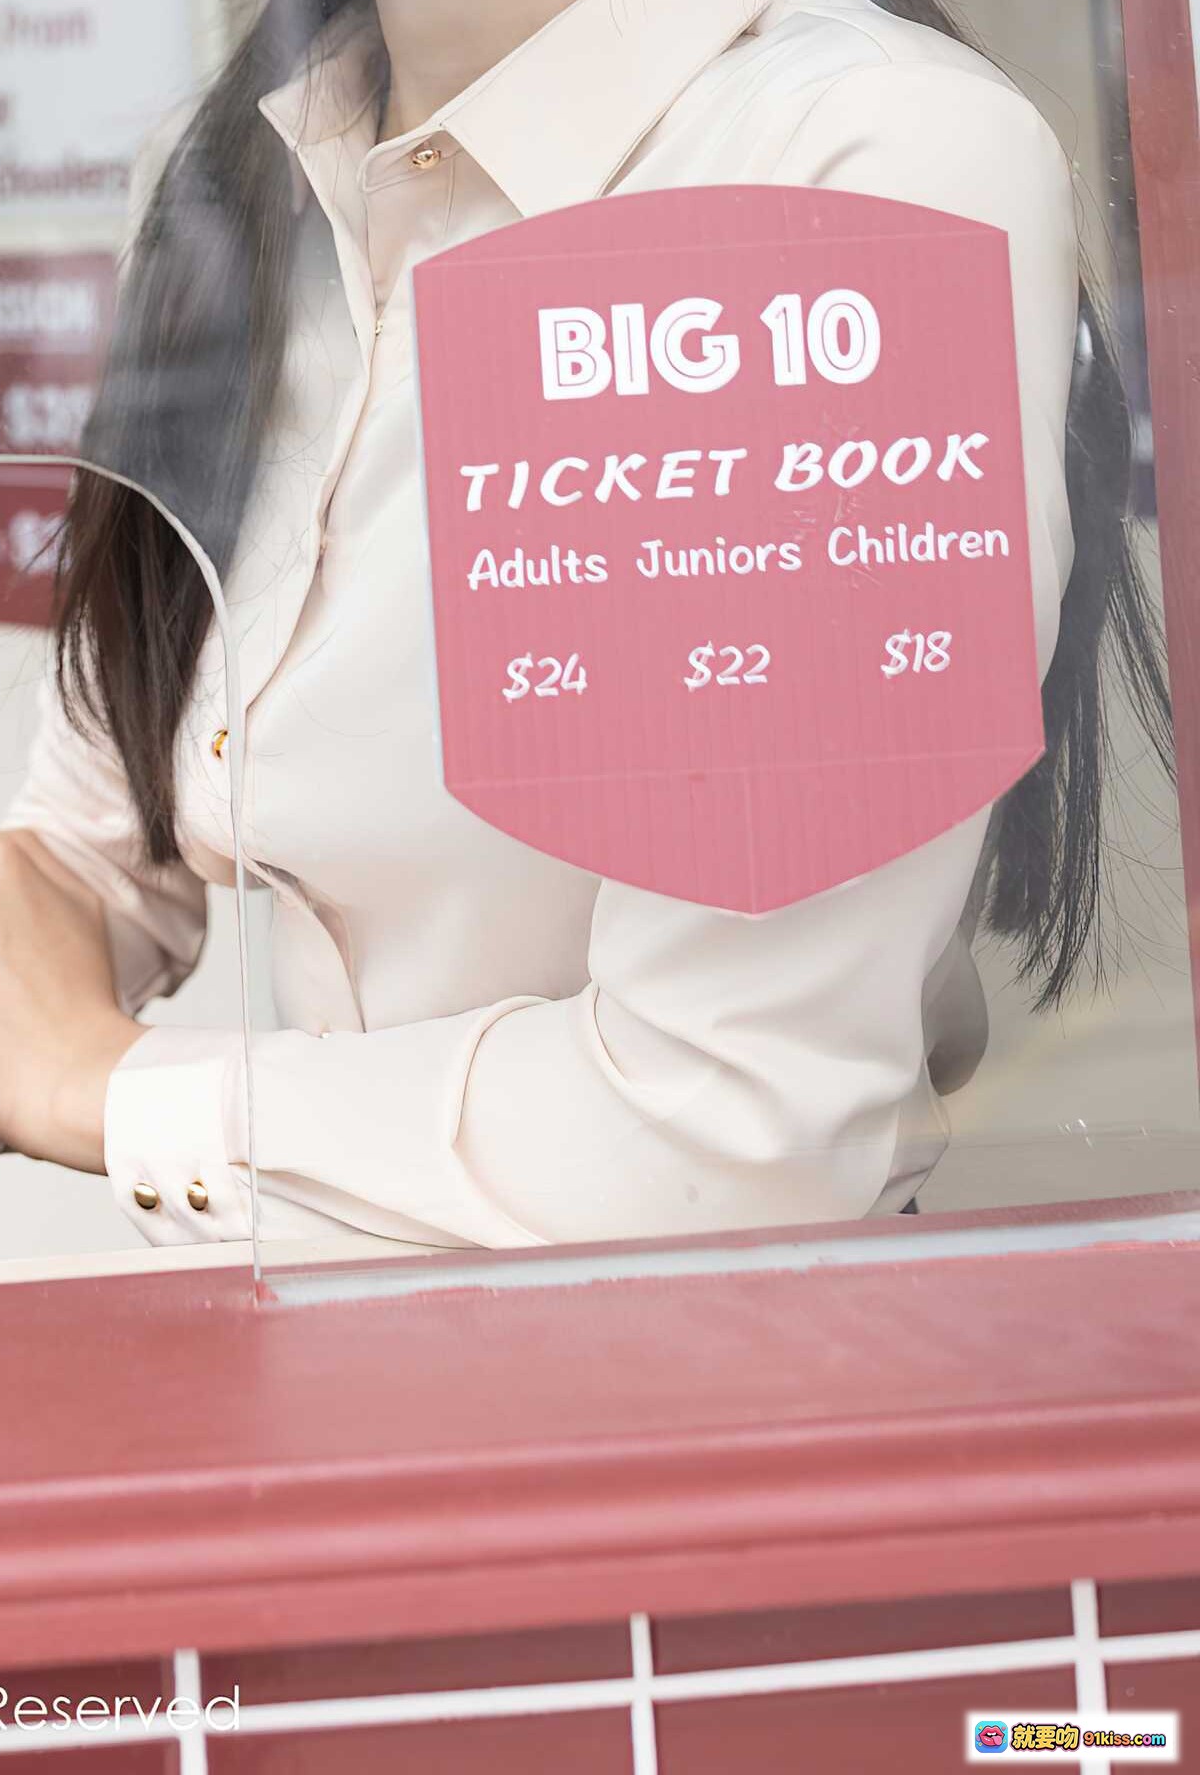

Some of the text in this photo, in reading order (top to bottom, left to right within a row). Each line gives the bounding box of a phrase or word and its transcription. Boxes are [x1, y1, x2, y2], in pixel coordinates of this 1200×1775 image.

[538, 289, 880, 400] BIG 10
[460, 433, 989, 511] TICKET BOOK
[467, 522, 1009, 590] Adults Juniors Children
[502, 629, 952, 702] $24 $22 $18
